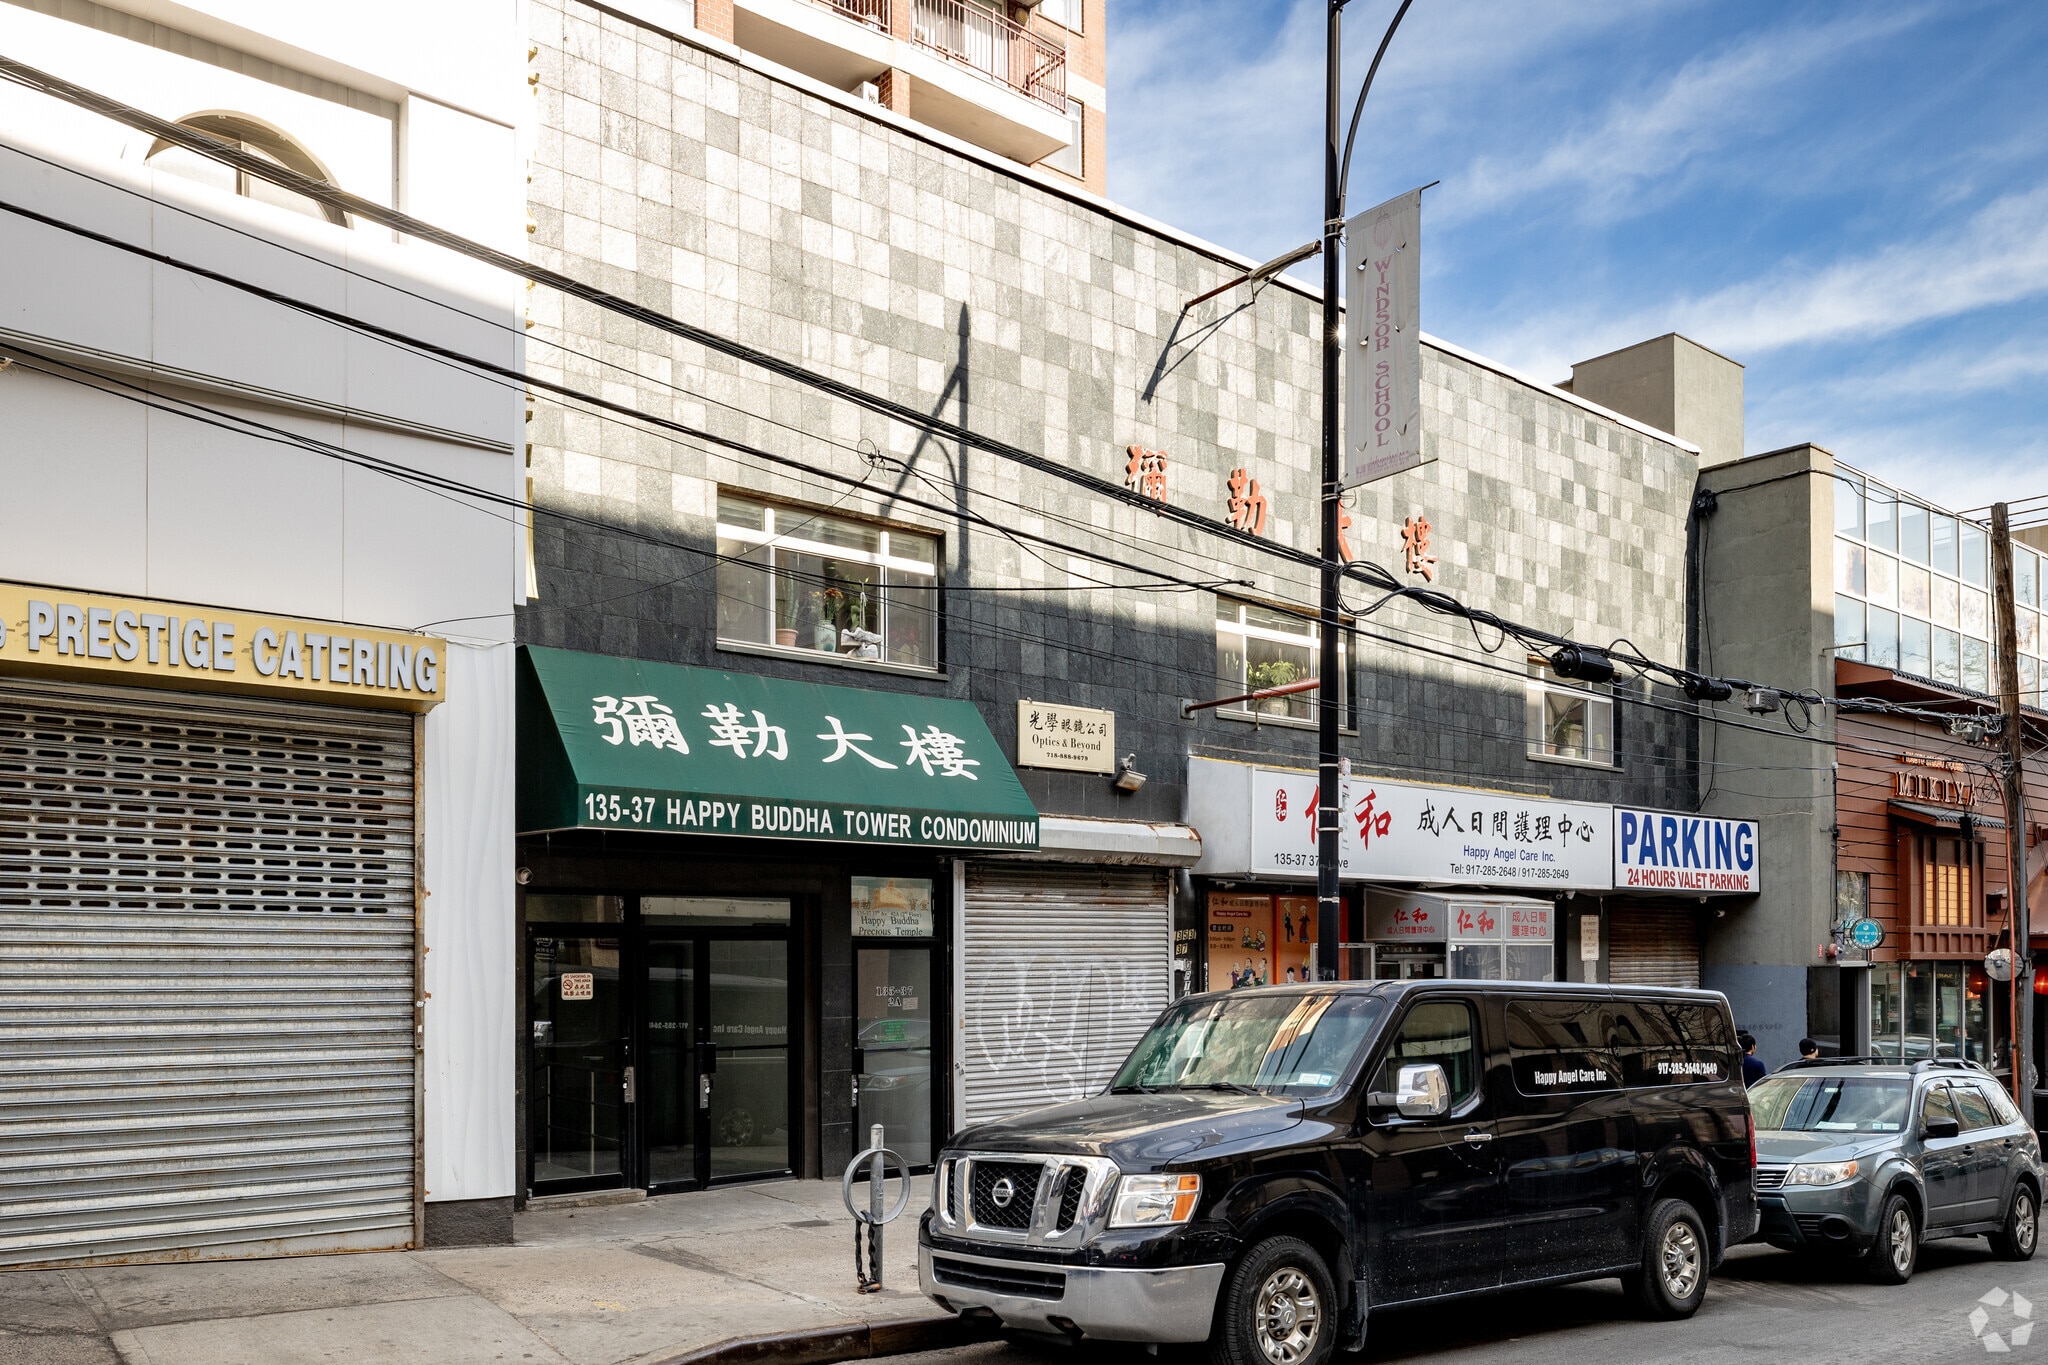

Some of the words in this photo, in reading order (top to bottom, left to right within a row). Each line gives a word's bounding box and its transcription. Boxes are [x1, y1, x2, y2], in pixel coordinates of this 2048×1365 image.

[1374, 255, 1392, 352] WINDSOR
[1374, 360, 1391, 447] SCHOOL
[28, 600, 236, 672] PRESTIGE
[253, 627, 438, 693] CATERING
[1029, 710, 1107, 737] 光學眼鏡公司
[592, 695, 981, 780] 彌勒大樓
[1032, 734, 1060, 748] Optics
[1062, 739, 1067, 747] &
[1071, 738, 1100, 752] Beyond
[1898, 772, 1978, 806] MIKIYA
[585, 793, 655, 824] 135-37
[667, 799, 741, 829] HAPPY
[751, 805, 833, 834] BUDDHA
[844, 810, 912, 838] TOWER
[921, 816, 1036, 844] CONDOMINIUM
[1416, 799, 1595, 849] 成人日間護理中心
[1621, 812, 1754, 871] PARKING
[1274, 853, 1306, 865] 135-37
[1464, 844, 1490, 861] Happy
[1494, 846, 1517, 862] Angel
[1520, 848, 1538, 862] Care
[1542, 850, 1556, 862] Inc.
[1450, 864, 1463, 875] Tel:
[1627, 869, 1639, 887] 24
[1641, 870, 1676, 888] HOURS
[1677, 871, 1708, 889] VALET
[1710, 872, 1749, 890] PARKING
[861, 916, 885, 926] Happy
[1394, 908, 1428, 923] 仁和
[1457, 909, 1494, 934] 仁和
[1512, 911, 1547, 923] 成人日間
[859, 927, 891, 936] Precious
[895, 927, 923, 936] Temple
[1512, 925, 1547, 937] 護理中心
[876, 986, 913, 996] 135-37
[888, 997, 901, 1006] 2A
[1535, 1070, 1557, 1085] Happy
[1558, 1069, 1578, 1084] Angel
[1580, 1069, 1594, 1082] Care
